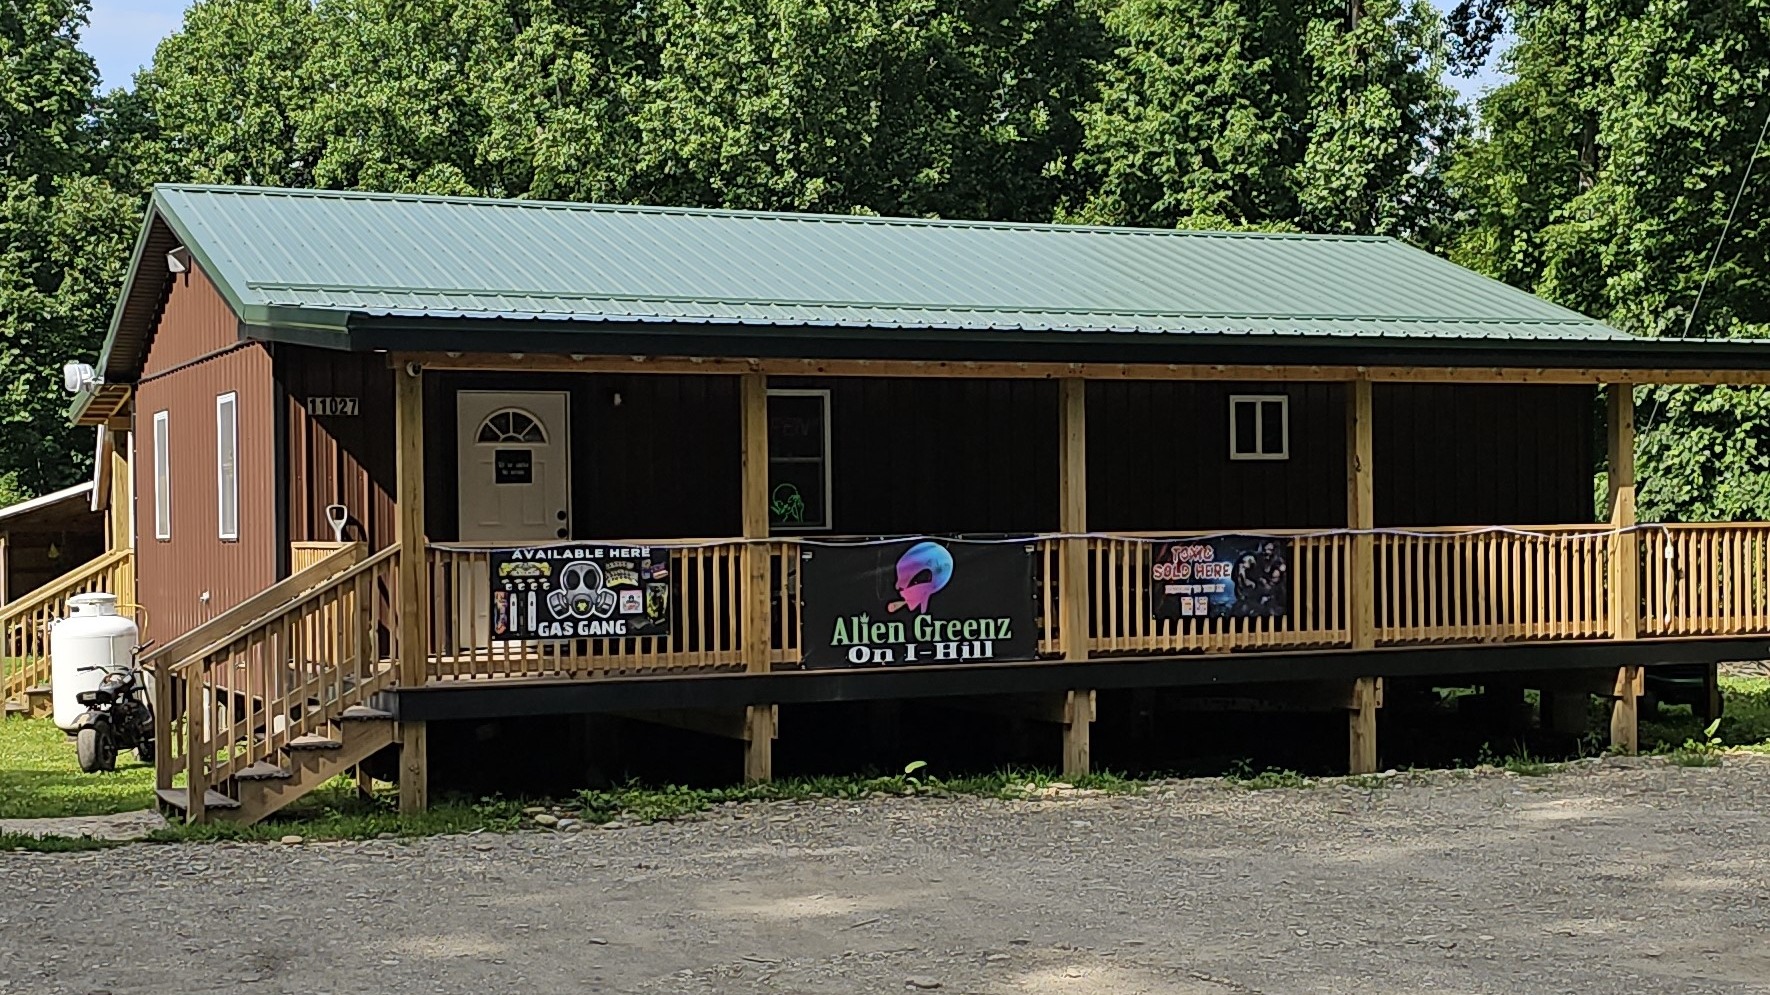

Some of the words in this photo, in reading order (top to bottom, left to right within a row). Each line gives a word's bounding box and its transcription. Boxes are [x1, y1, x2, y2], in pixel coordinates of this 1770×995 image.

[309, 397, 357, 415] 11027
[511, 548, 604, 560] AVAILABLE
[610, 548, 650, 558] HERE
[1171, 545, 1215, 562] TOXIC
[1153, 562, 1191, 580] SOLD
[1194, 561, 1233, 579] HERE
[538, 621, 574, 637] GAS
[577, 619, 627, 636] GANG
[830, 612, 906, 646] Alien
[914, 614, 1012, 642] Greenz
[848, 645, 895, 664] On
[904, 641, 994, 663] I-Hill
